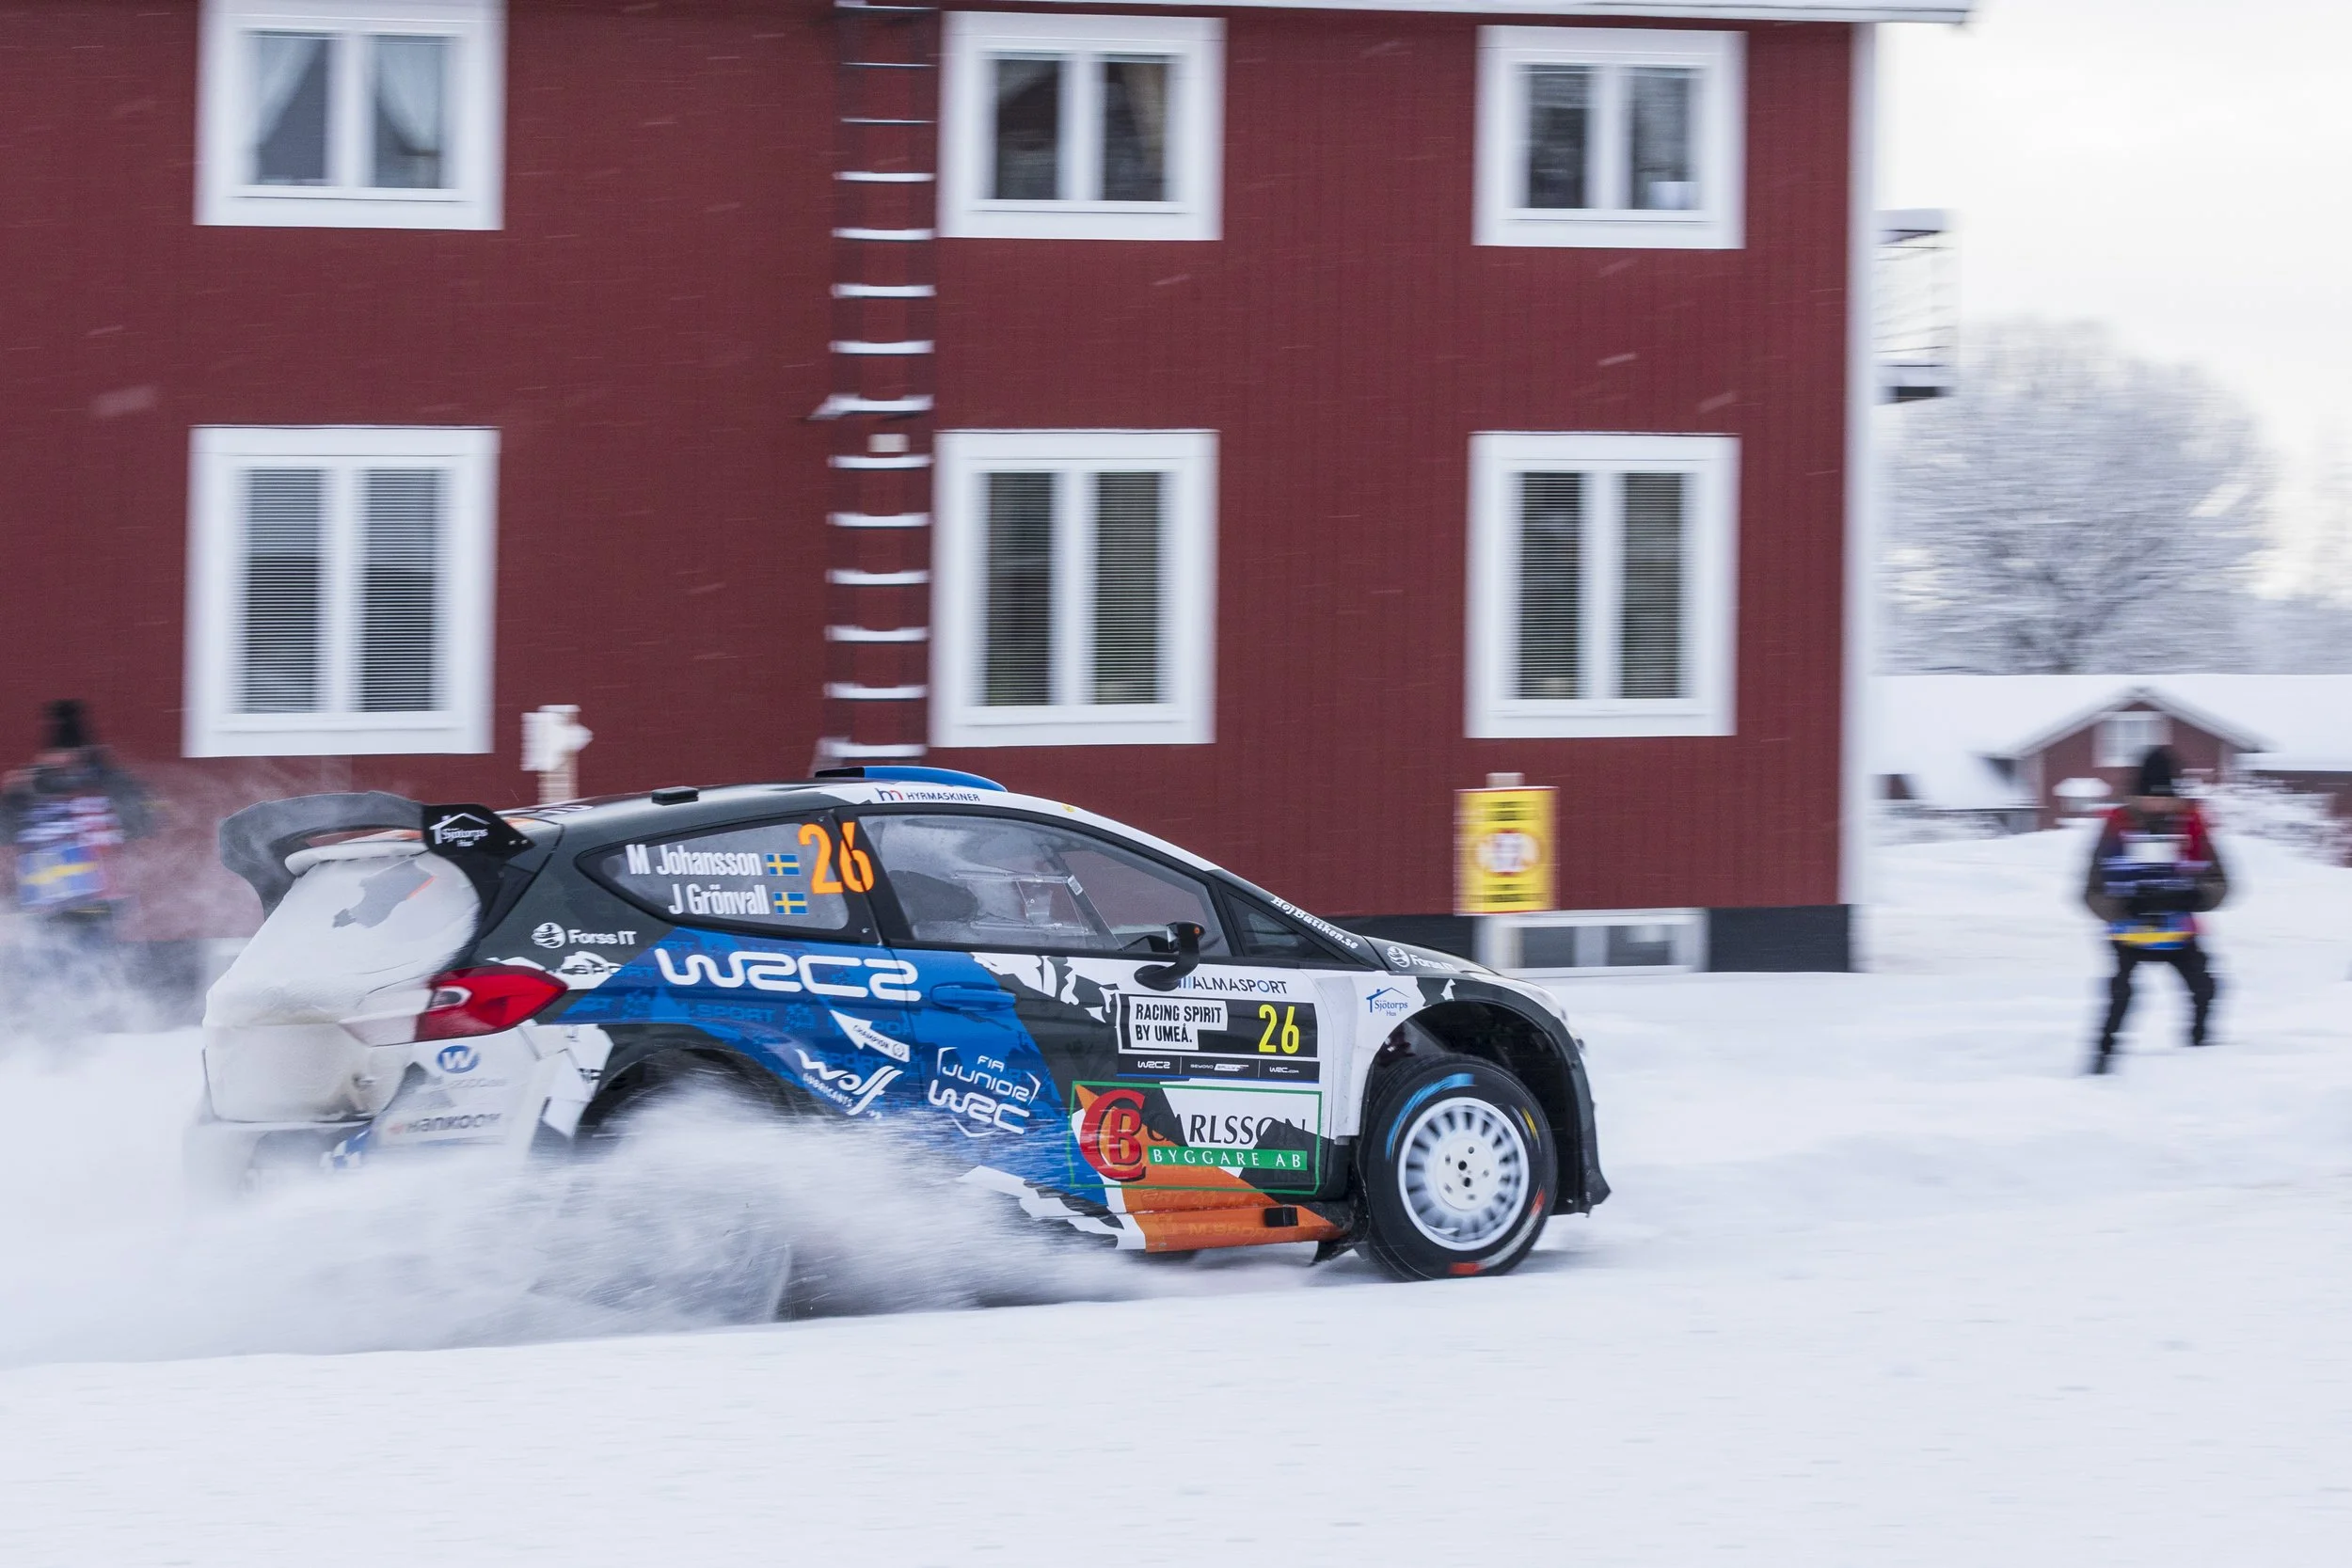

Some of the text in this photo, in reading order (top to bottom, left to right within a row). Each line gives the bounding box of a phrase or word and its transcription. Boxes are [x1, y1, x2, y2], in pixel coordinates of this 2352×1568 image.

[906, 791, 980, 802] HYRMASKINER
[625, 844, 763, 876] M Johansson
[798, 821, 875, 894] 26
[668, 883, 771, 915] J Grönvall
[567, 929, 618, 944] Forss
[654, 948, 922, 1002] WRC2
[1193, 977, 1288, 995] ALMASPORT
[1136, 1003, 1222, 1024] RACING SPIRIT
[1375, 998, 1408, 1012] Sjötorps
[1136, 1023, 1193, 1043] BY UMEÅ.
[1258, 1004, 1300, 1054] 26
[977, 1055, 1006, 1072] FIA
[1137, 1060, 1171, 1069] WRC2
[942, 1064, 1030, 1102] JUNIOR
[928, 1079, 1031, 1134] WRC
[1152, 1148, 1301, 1168] BYGGARE AB
